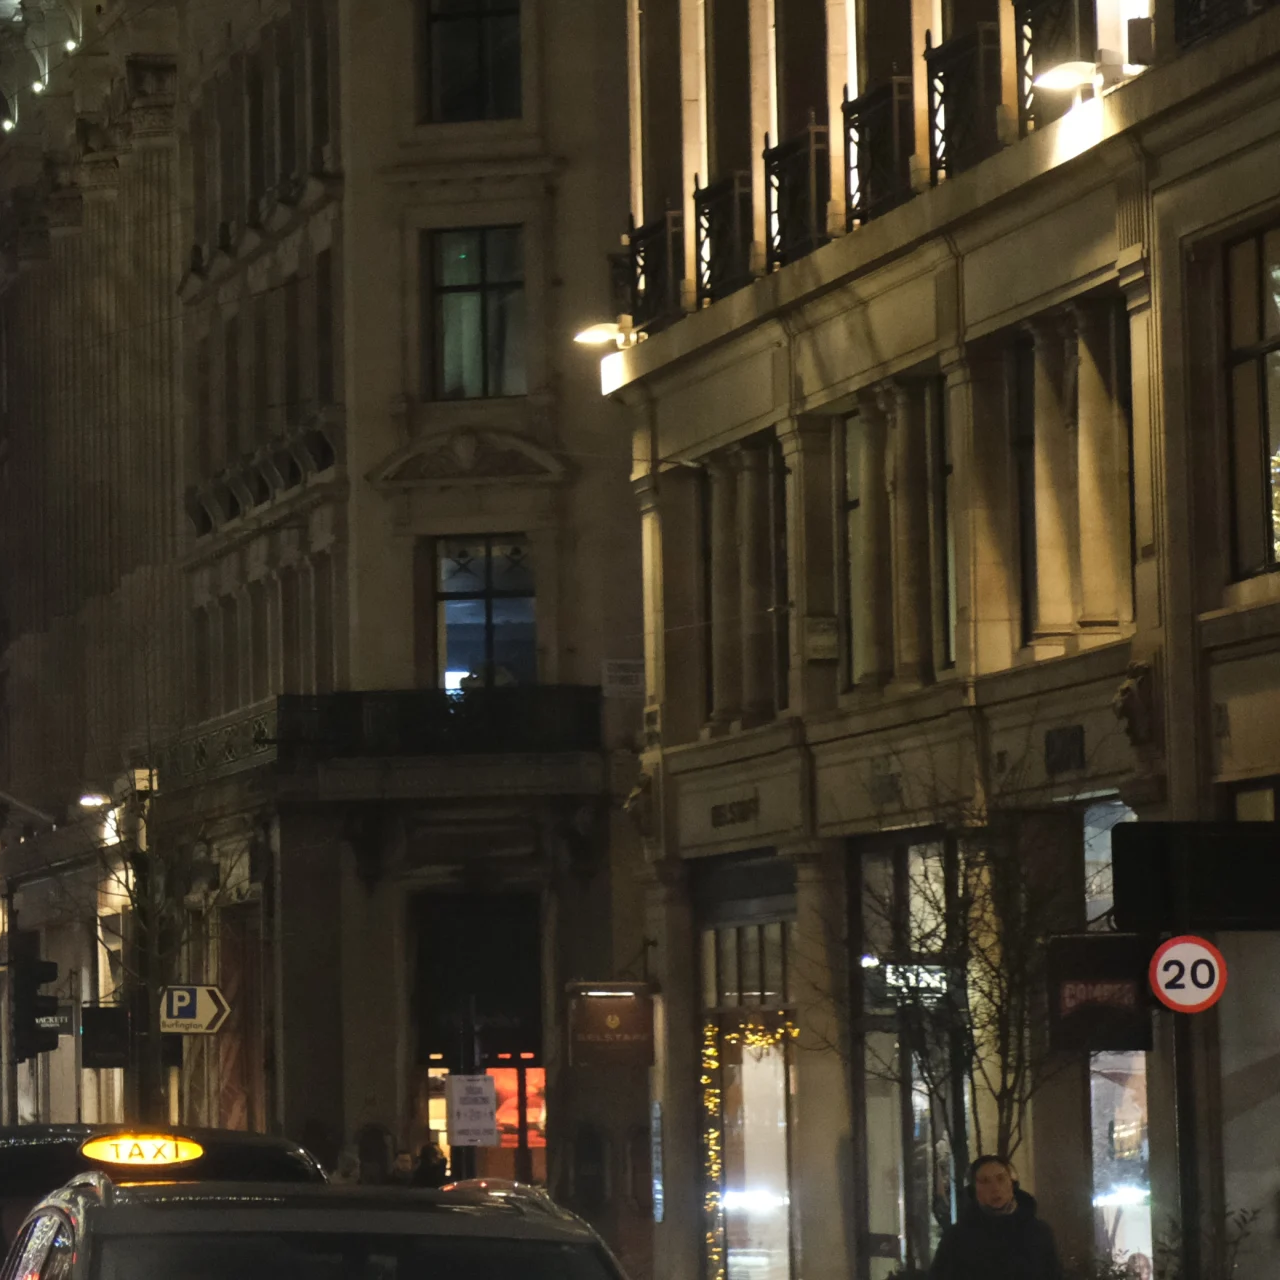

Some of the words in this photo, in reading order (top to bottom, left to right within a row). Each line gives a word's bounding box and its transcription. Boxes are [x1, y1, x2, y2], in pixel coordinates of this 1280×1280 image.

[1163, 959, 1215, 989] 20
[173, 990, 190, 1017] P
[161, 1021, 203, 1030] Burlington
[110, 1143, 179, 1160] TAXI
